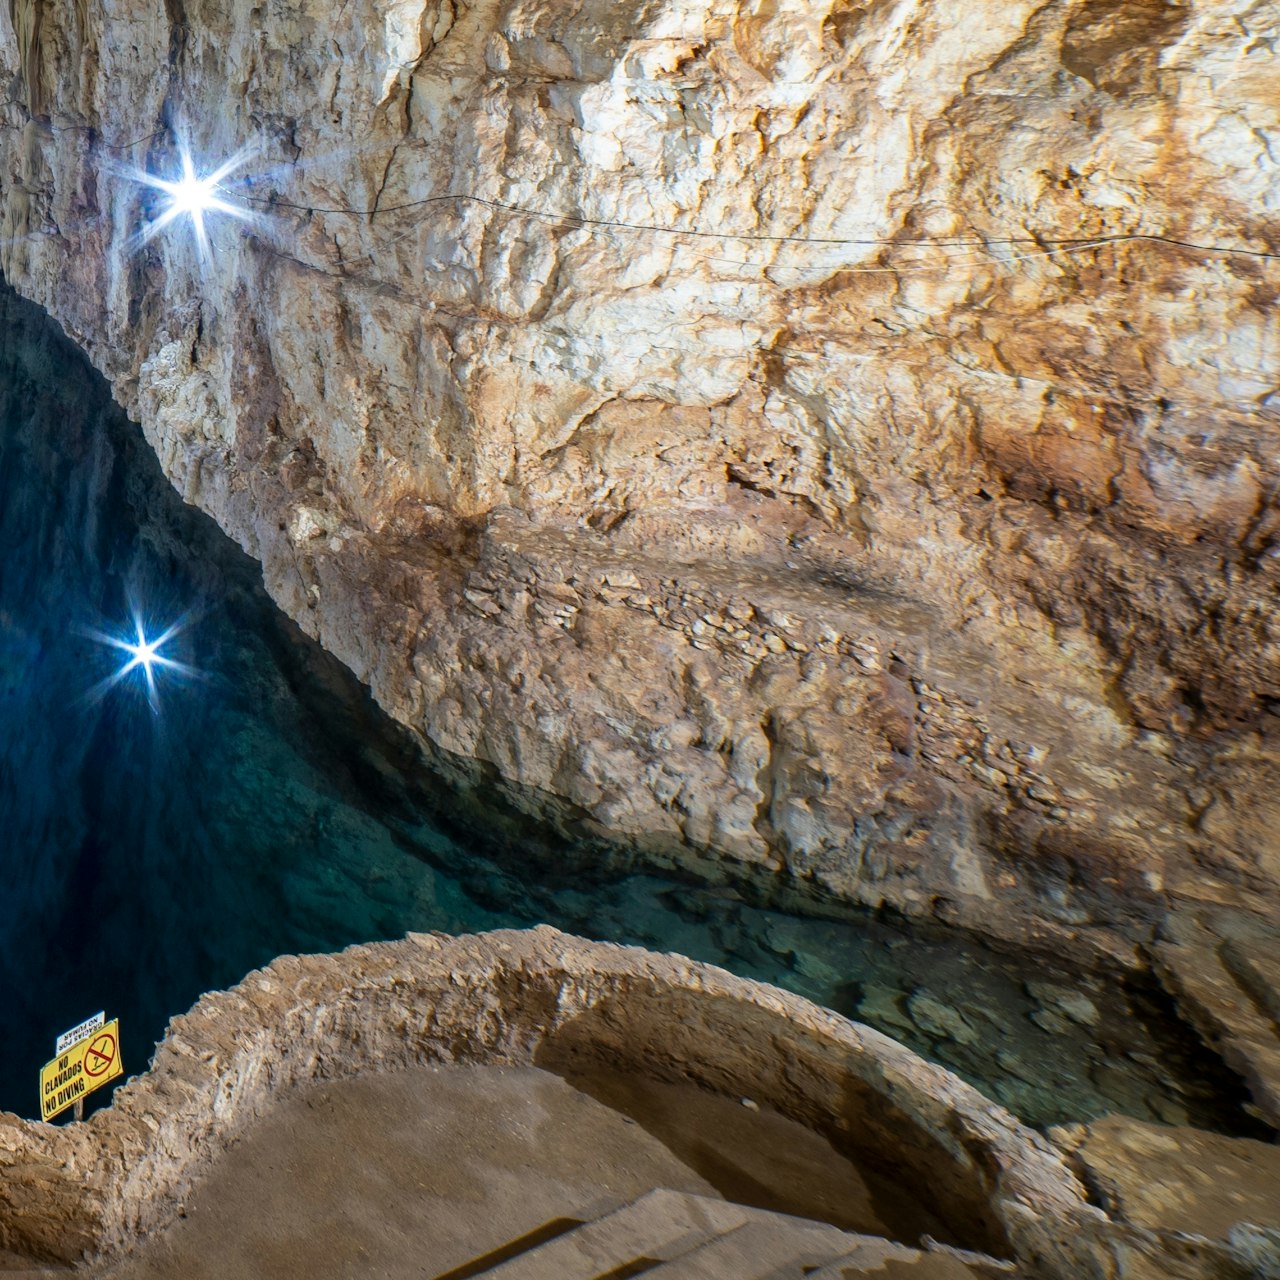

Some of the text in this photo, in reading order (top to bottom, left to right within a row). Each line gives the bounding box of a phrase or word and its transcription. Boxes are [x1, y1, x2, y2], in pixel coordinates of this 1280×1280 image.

[59, 1022, 102, 1051] GRACIAS POR
[64, 1017, 98, 1041] NO FUMAR
[45, 1060, 82, 1095] CLAVADOS
[59, 1056, 69, 1072] NO
[46, 1077, 85, 1114] NO DIVING
